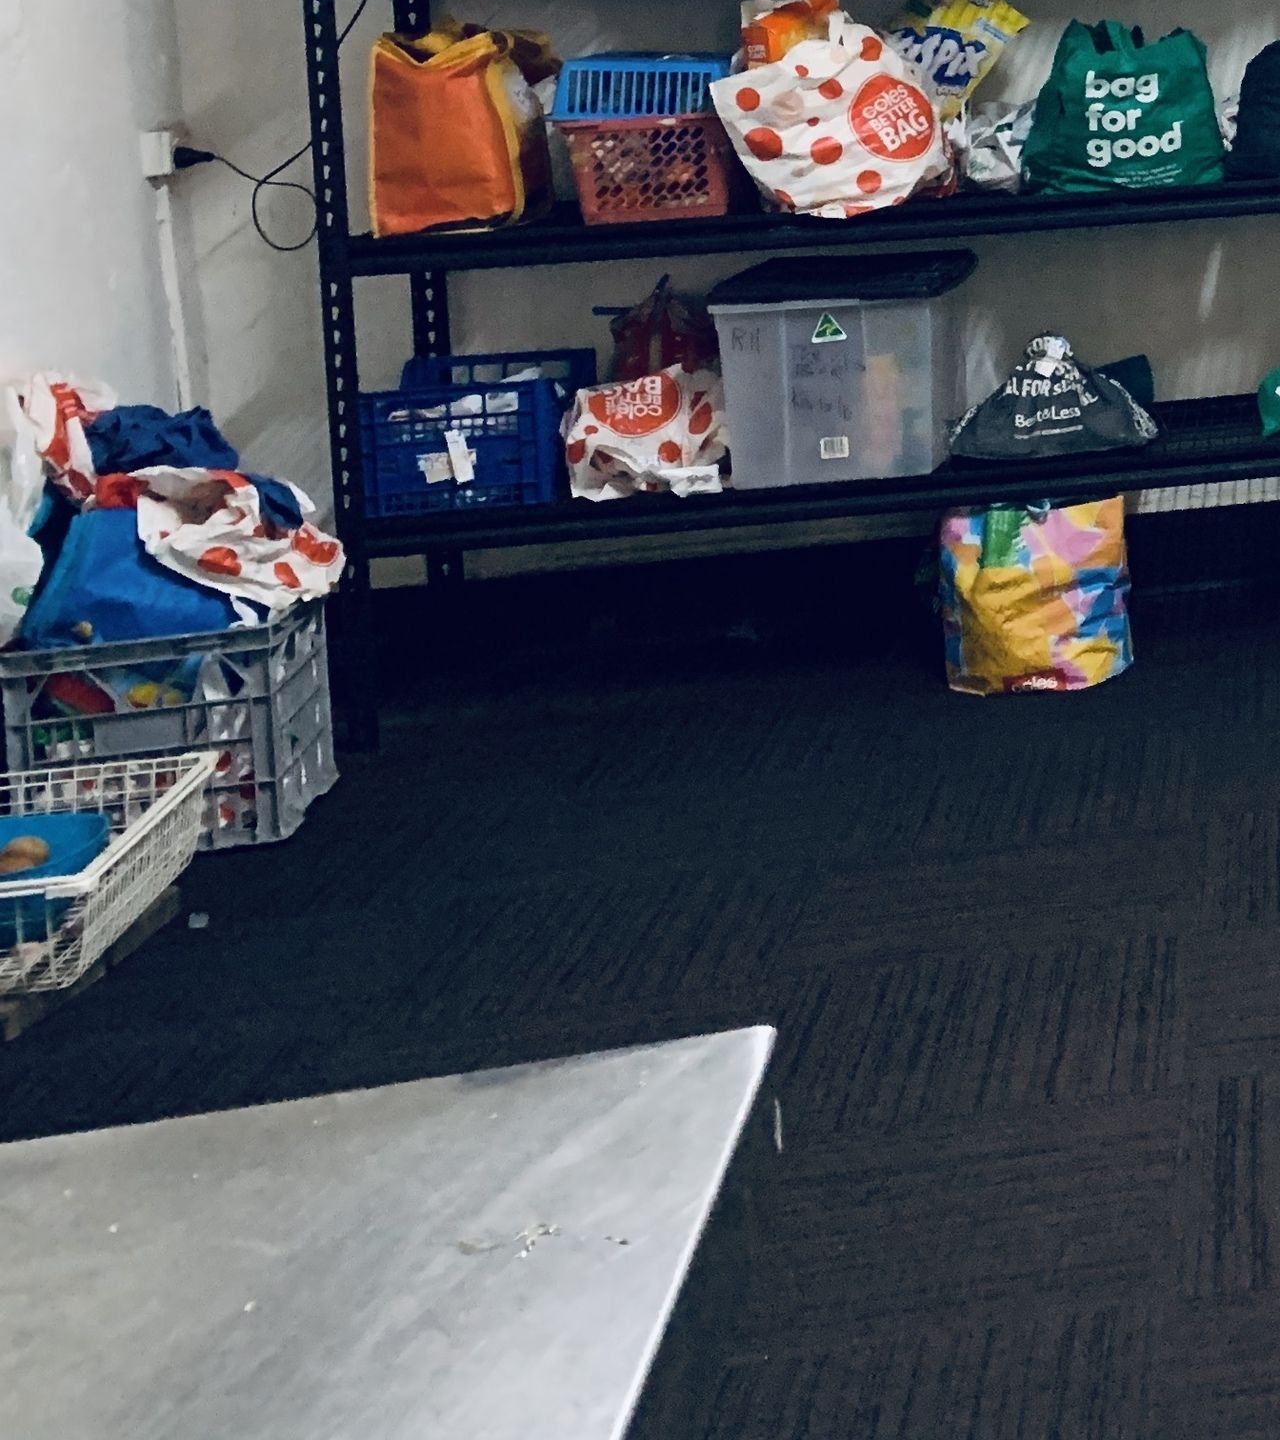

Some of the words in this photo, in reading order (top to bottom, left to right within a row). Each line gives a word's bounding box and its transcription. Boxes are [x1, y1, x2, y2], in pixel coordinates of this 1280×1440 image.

[862, 84, 908, 120] coles
[1085, 70, 1159, 104] bag
[868, 97, 917, 132] BETTER
[878, 108, 929, 152] BAG
[1085, 102, 1142, 132] for
[1086, 120, 1184, 168] good
[1022, 378, 1051, 397] FOR
[1015, 405, 1081, 428] Bet&Less
